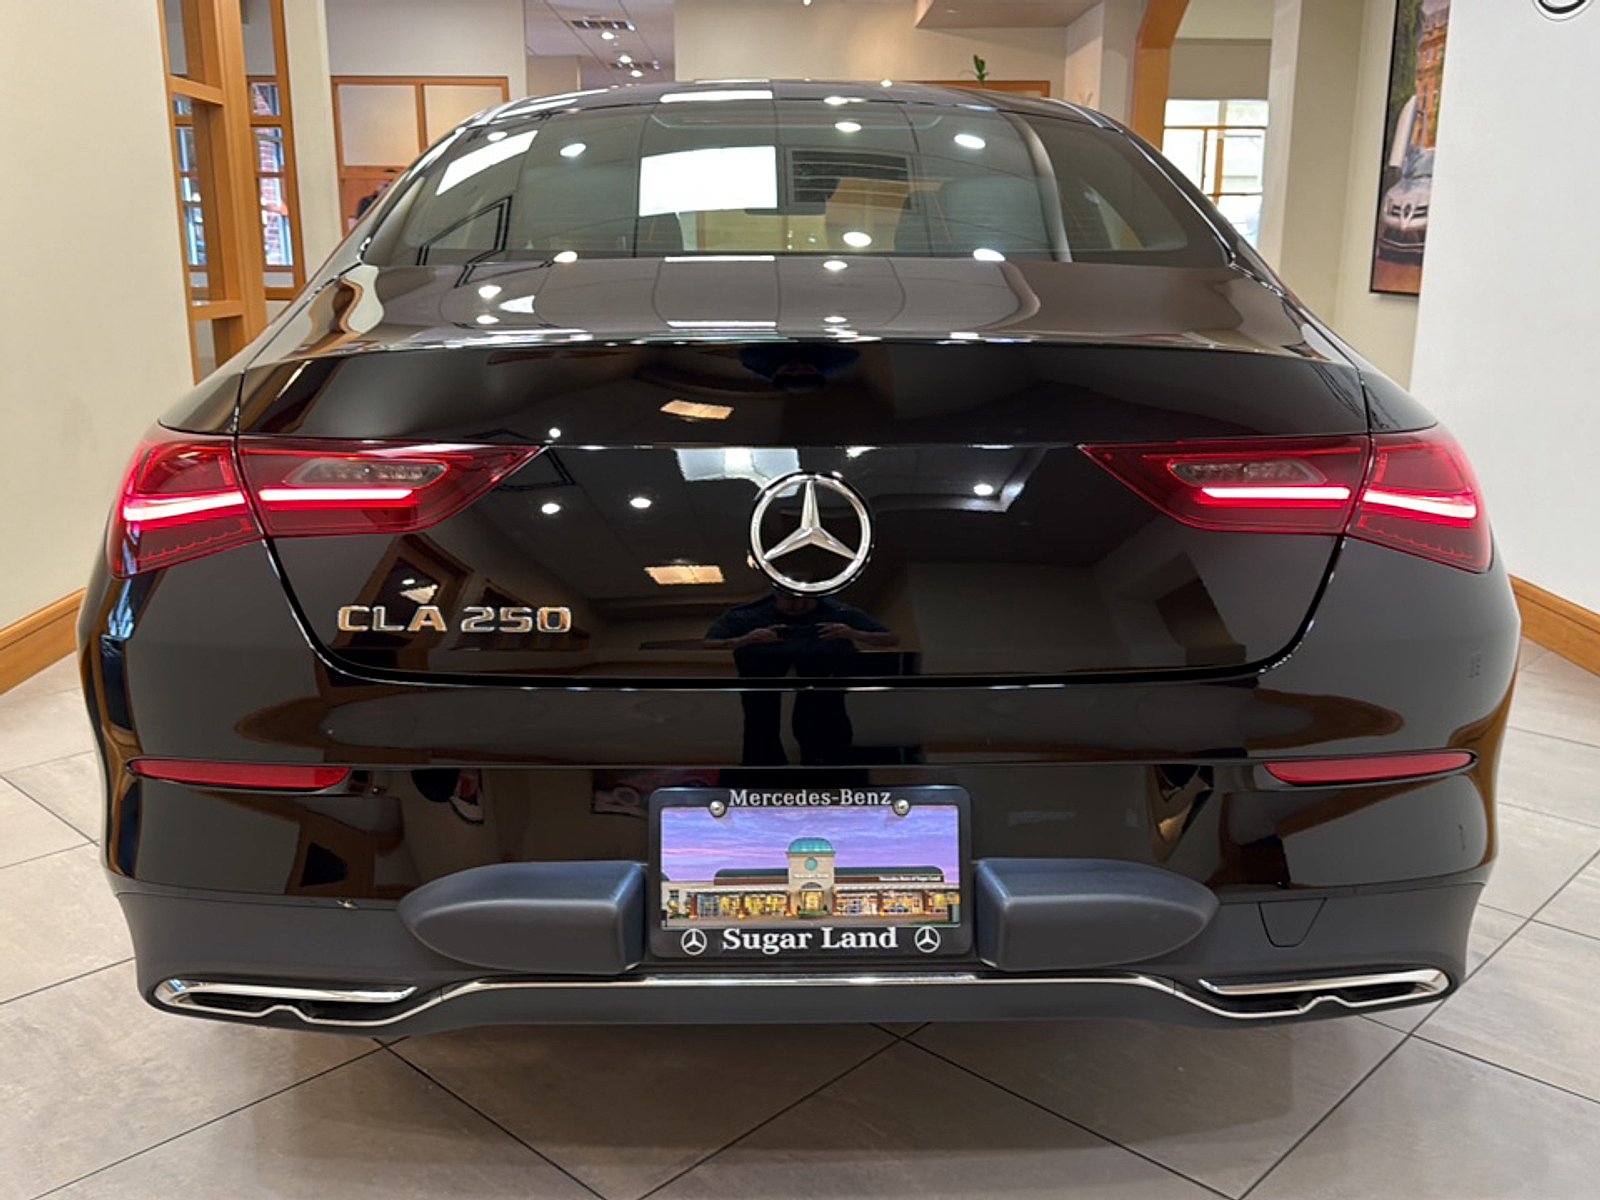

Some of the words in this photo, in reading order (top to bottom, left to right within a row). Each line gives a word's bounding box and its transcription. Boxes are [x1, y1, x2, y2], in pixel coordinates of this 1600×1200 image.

[337, 605, 448, 633] CLA
[461, 606, 571, 633] 250
[729, 788, 891, 806] Mercedes-Benz
[722, 928, 813, 955] Sugar
[820, 926, 898, 949] Land
